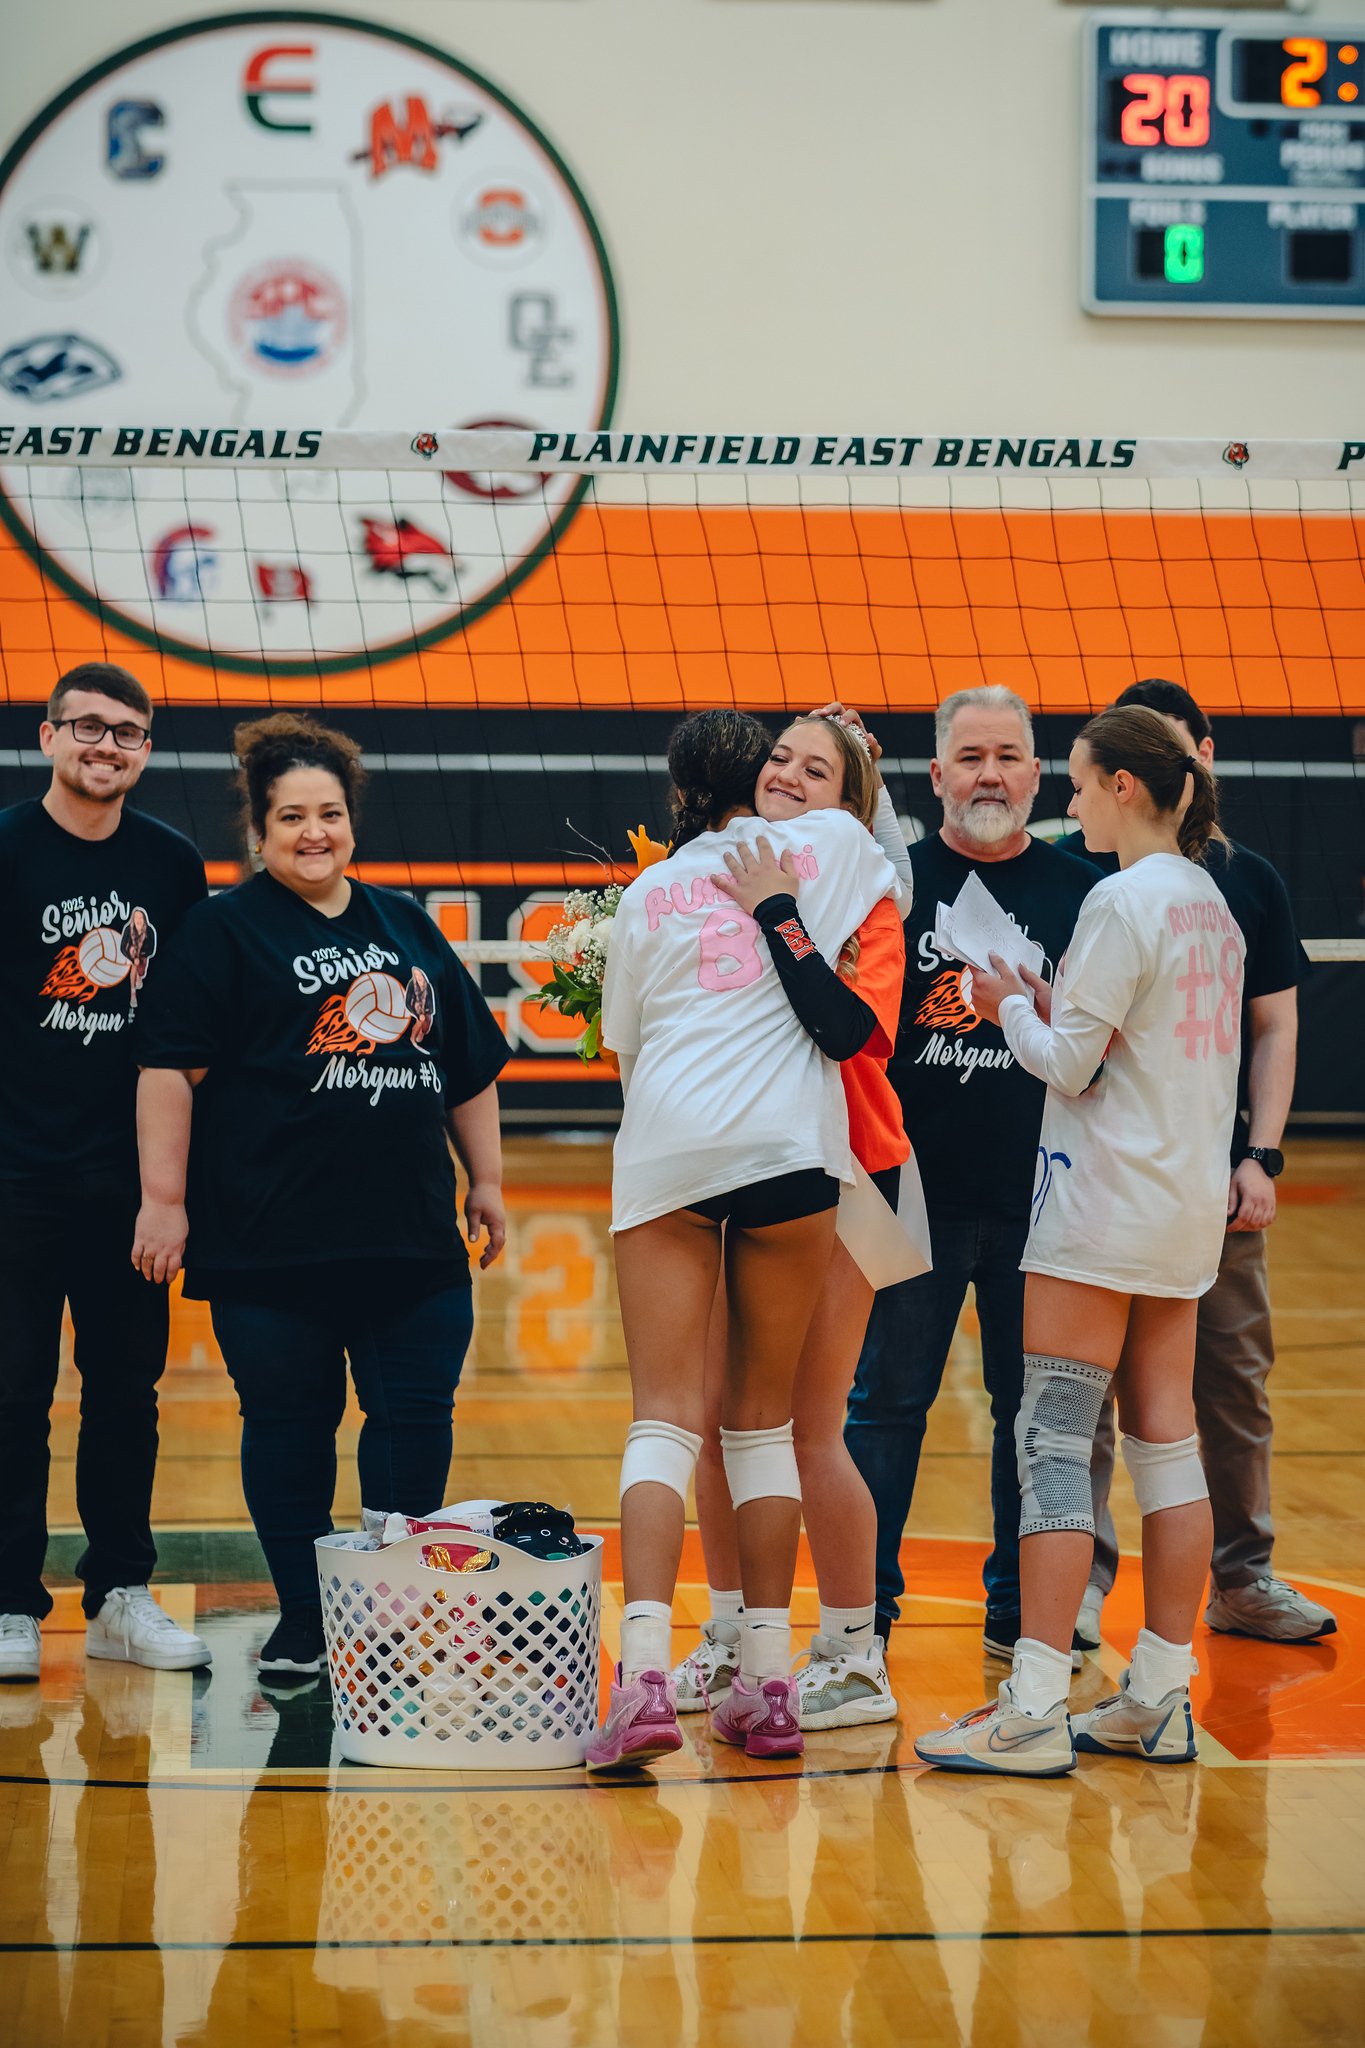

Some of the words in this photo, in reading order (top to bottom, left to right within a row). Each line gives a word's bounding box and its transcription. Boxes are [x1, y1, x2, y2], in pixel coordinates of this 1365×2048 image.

[1121, 73, 1210, 147] 20
[1164, 222, 1205, 283] 0
[0, 426, 102, 455] EAST
[112, 428, 322, 458] BENGALS
[528, 433, 800, 465] PLAINFIELD
[810, 437, 923, 466] EAST
[931, 438, 1137, 468] BENGALS
[41, 890, 131, 944] Senior
[61, 896, 85, 914] 2025
[312, 946, 342, 962] 2025
[774, 917, 817, 961] EAST
[293, 943, 399, 995] Senior
[39, 999, 125, 1046] Morgan
[1174, 935, 1242, 1062] #8
[310, 1054, 417, 1107] Morgan
[914, 1032, 1014, 1084] Morgan
